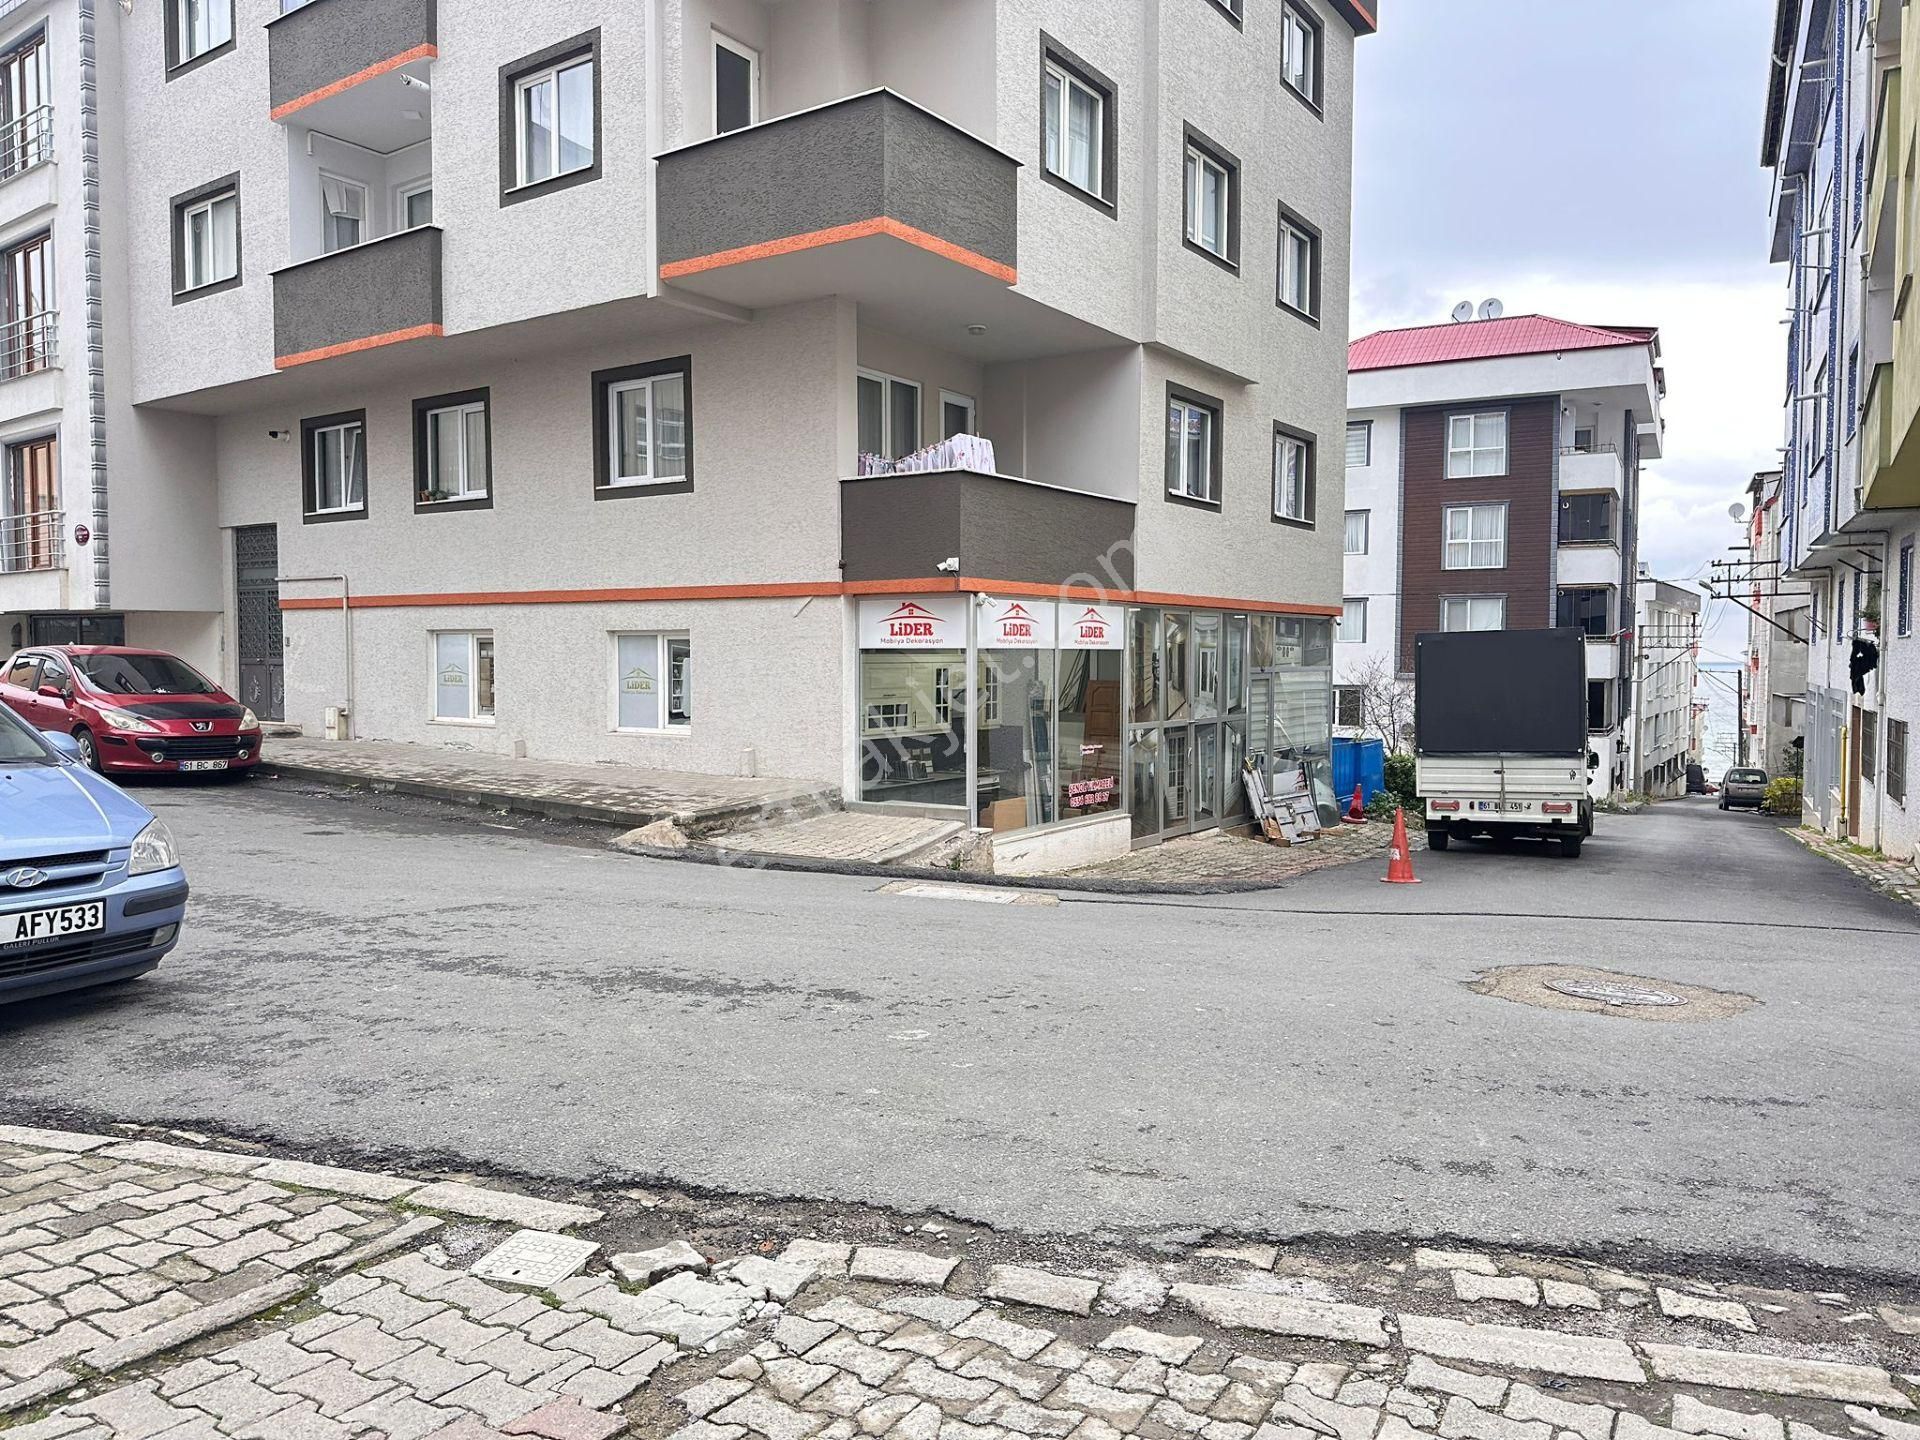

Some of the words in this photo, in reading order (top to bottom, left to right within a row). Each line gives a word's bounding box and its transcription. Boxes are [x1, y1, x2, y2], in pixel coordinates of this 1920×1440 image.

[880, 637, 905, 645] Mobilya
[906, 637, 944, 645] Dekorasyon
[15, 904, 100, 939] AFY533
